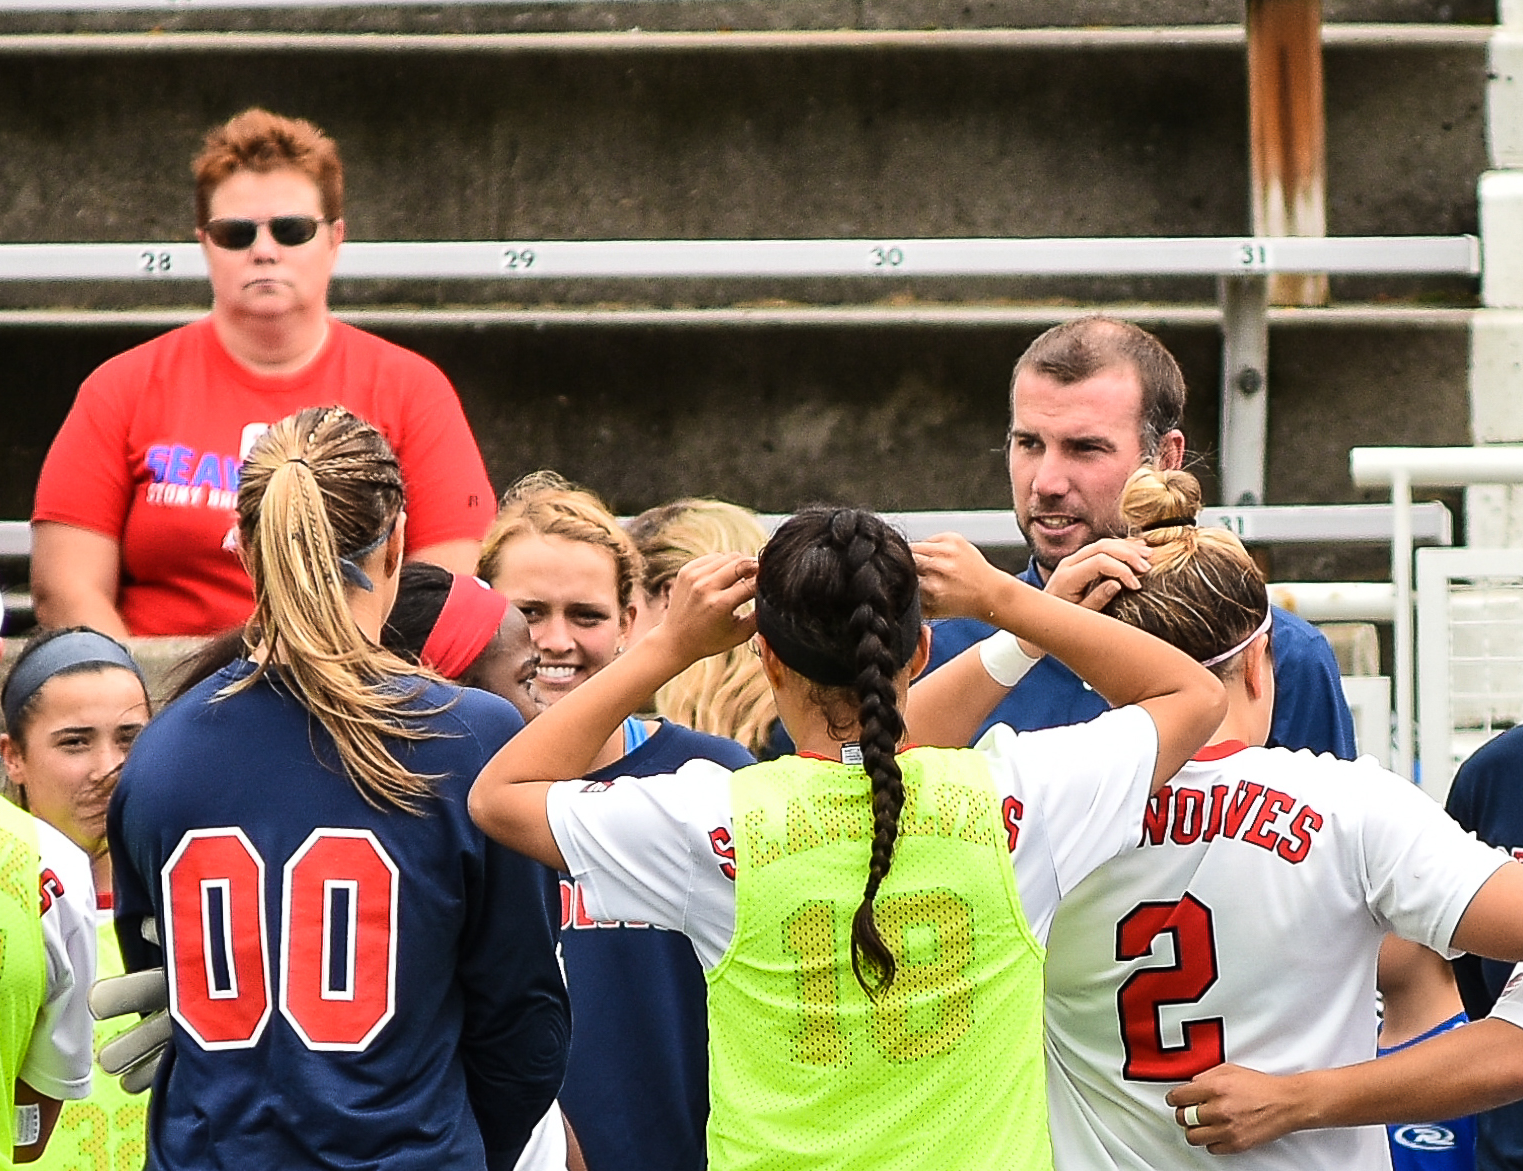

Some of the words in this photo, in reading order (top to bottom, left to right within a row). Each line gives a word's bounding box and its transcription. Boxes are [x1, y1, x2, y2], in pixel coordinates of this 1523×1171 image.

[140, 252, 171, 272] 28
[503, 250, 535, 270] 29
[873, 247, 905, 267] 30
[1241, 245, 1266, 265] 31
[1219, 515, 1245, 537] 31
[161, 826, 401, 1052] 00
[1116, 890, 1227, 1083] 2
